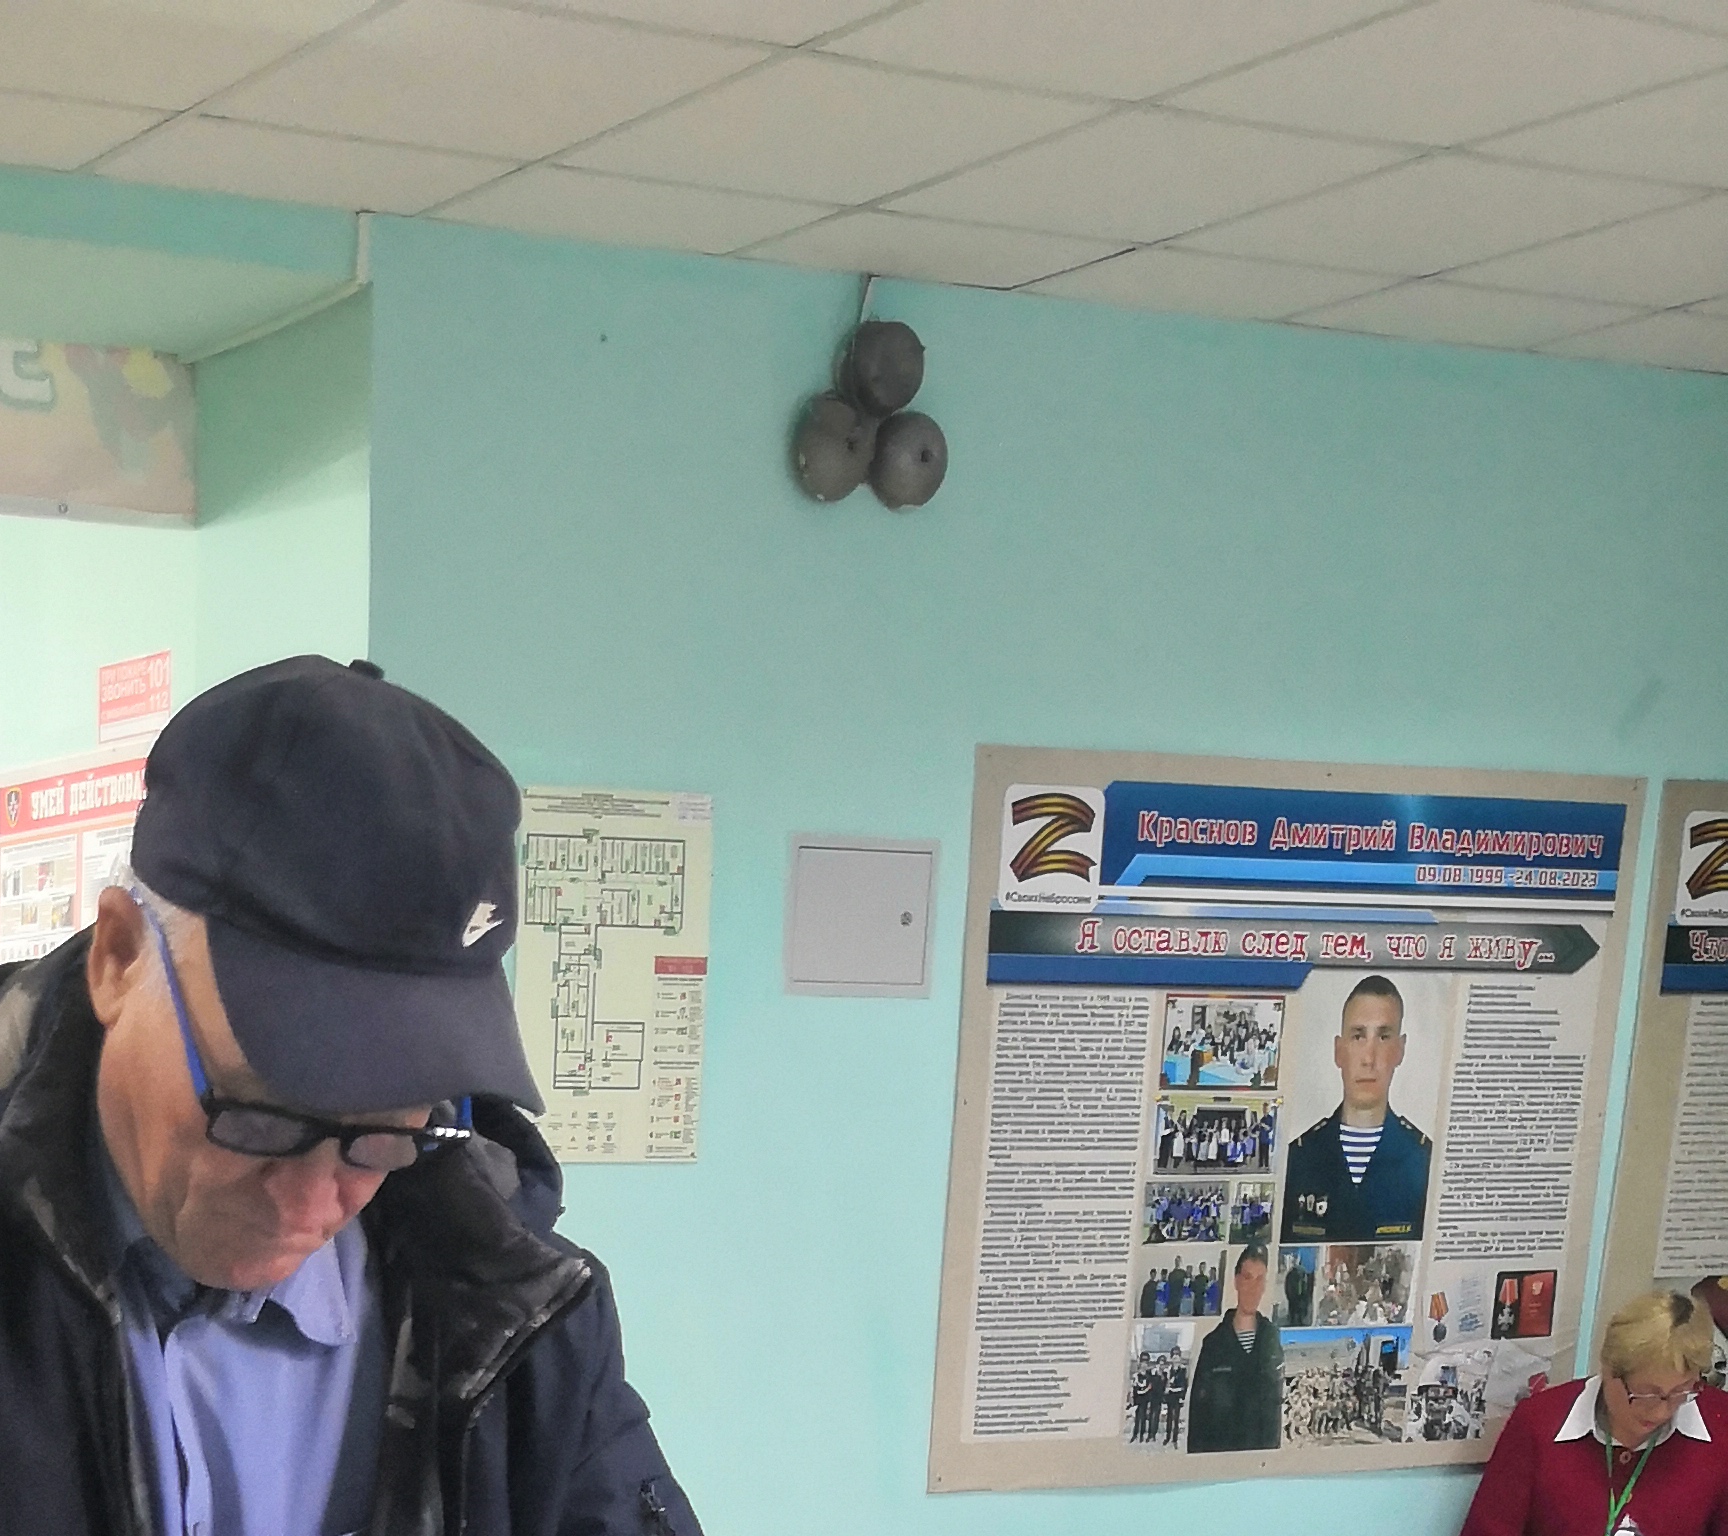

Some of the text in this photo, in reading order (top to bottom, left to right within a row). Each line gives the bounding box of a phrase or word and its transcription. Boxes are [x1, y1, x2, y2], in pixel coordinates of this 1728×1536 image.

[101, 677, 147, 703] ЗВОНИТЬ
[148, 655, 170, 690] 101
[149, 690, 169, 712] 112
[31, 768, 147, 820] УМЕЙ ДЕЙСТВОВА
[1137, 810, 1605, 859] Краснов Дмитрий Владимирович
[1076, 918, 1102, 953] Я
[1112, 925, 1229, 955] оставлю
[1240, 930, 1310, 963] след
[1320, 931, 1374, 962] тем,
[1386, 934, 1430, 961] что
[1437, 934, 1460, 961] я
